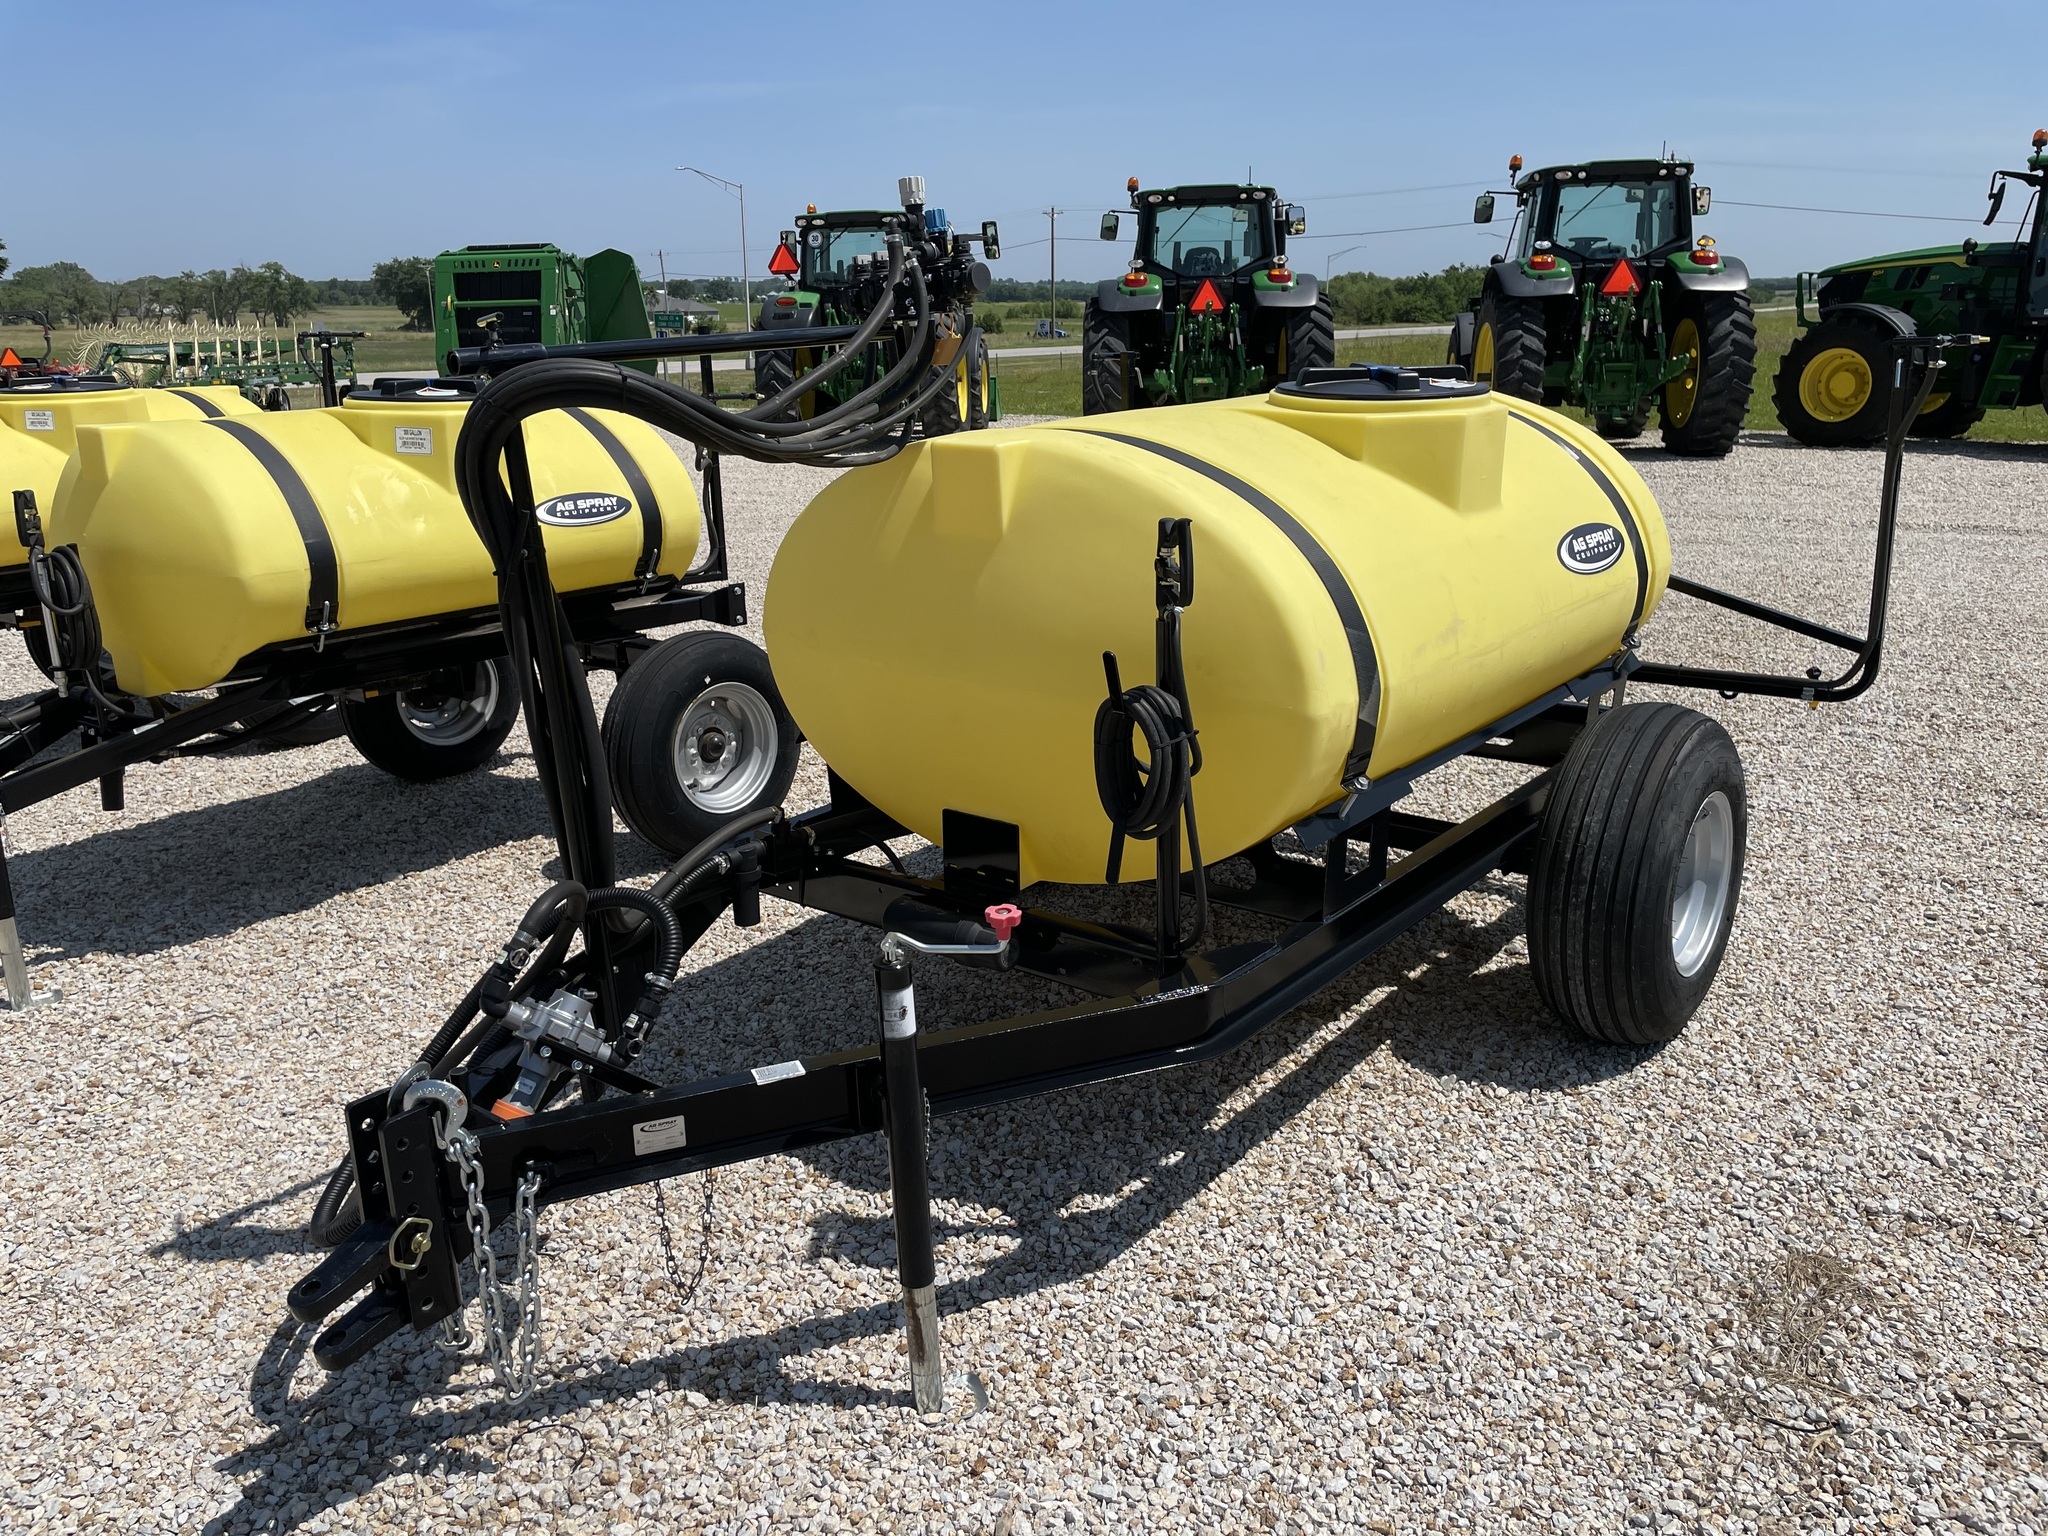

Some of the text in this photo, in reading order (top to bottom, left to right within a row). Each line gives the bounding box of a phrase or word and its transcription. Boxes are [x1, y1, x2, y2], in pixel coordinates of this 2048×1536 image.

[556, 496, 618, 512] AG SPRAY
[556, 505, 618, 517] EQUIPMENT
[1572, 527, 1615, 553] AG SPRAY
[1575, 541, 1617, 561] EQUIPMENT
